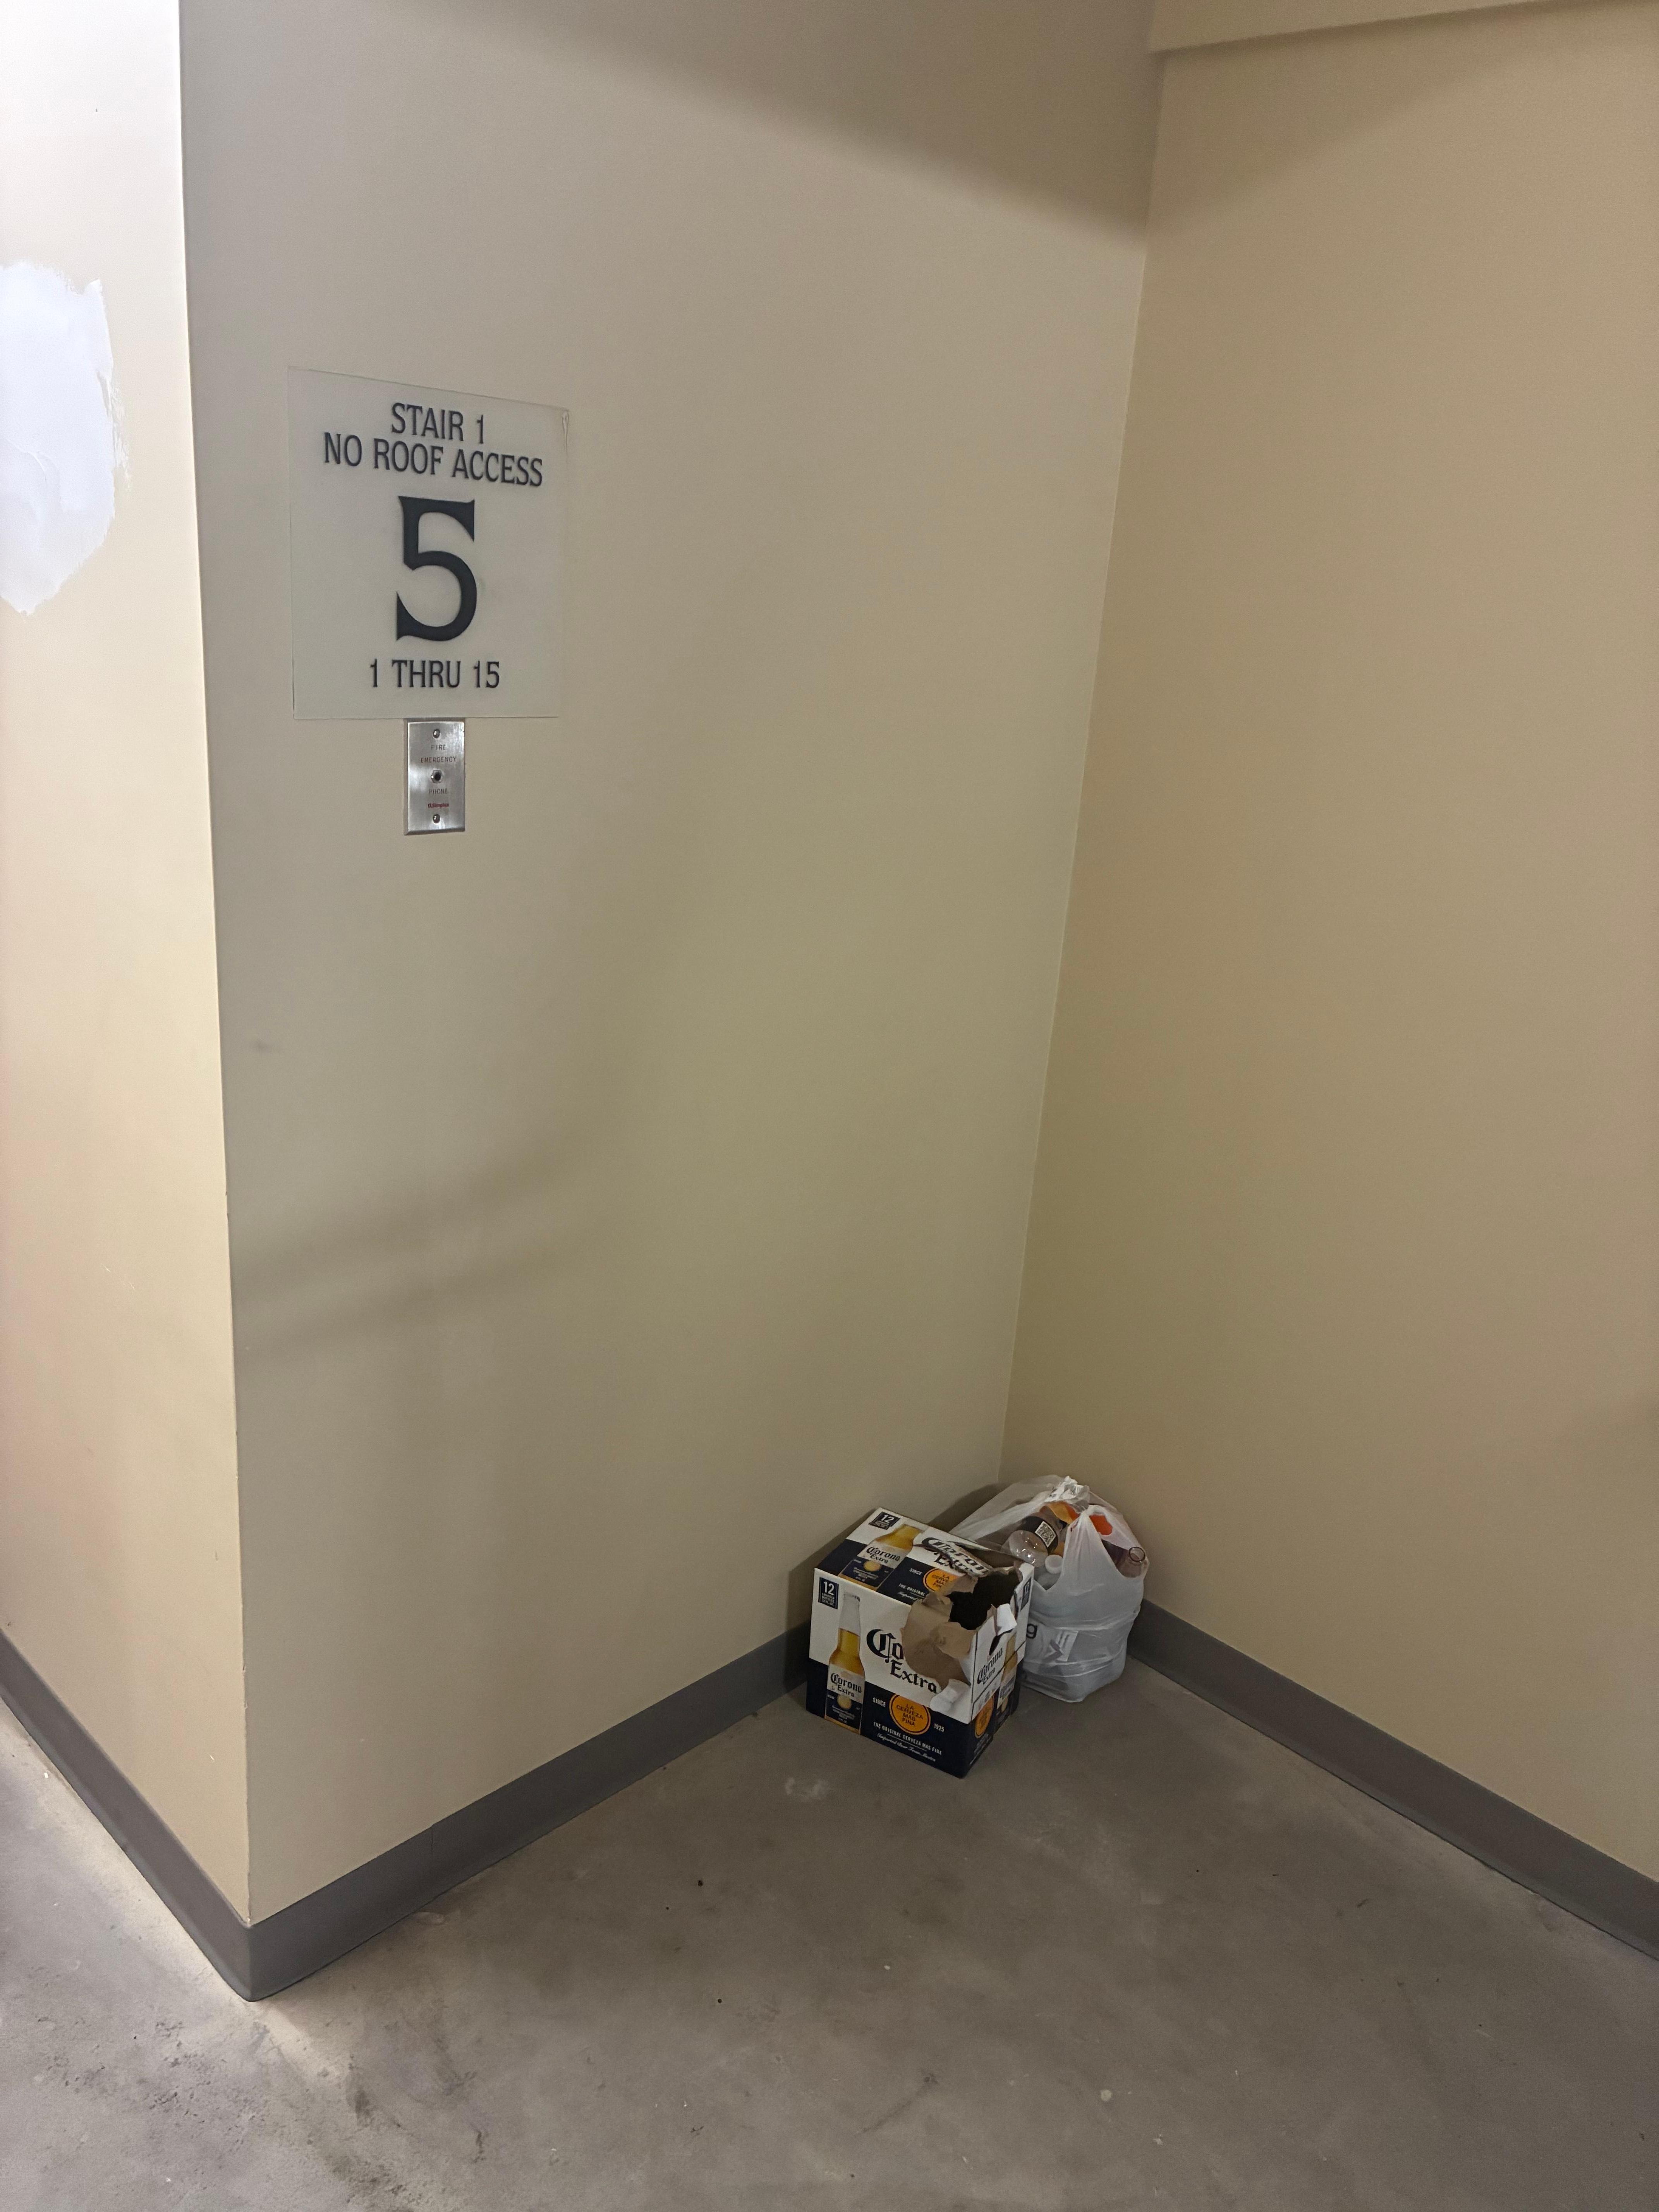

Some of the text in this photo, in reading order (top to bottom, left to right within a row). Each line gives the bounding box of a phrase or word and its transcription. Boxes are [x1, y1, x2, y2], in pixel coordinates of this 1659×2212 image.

[391, 402, 485, 444] STAIR 1
[324, 432, 543, 487] NO ROOF ACCESS
[396, 495, 477, 642] 5
[370, 659, 501, 688] 1 THRU 15
[881, 1514, 895, 1523] 12
[866, 1546, 900, 1561] Corona
[870, 1554, 888, 1564] Extra
[824, 1581, 834, 1595] 12
[977, 1648, 1002, 1685] Corona
[830, 1673, 862, 1693] Corona
[890, 1659, 937, 1694] Extra
[838, 1684, 855, 1697] Extra
[872, 1697, 886, 1707] SINCE
[896, 1705, 923, 1719] CERVEZA
[902, 1717, 915, 1726] FINA
[934, 1723, 945, 1732] 1925
[882, 1725, 902, 1738] ORIGINAL
[902, 1735, 921, 1746] CERVEZA
[932, 1747, 942, 1755] FINA
